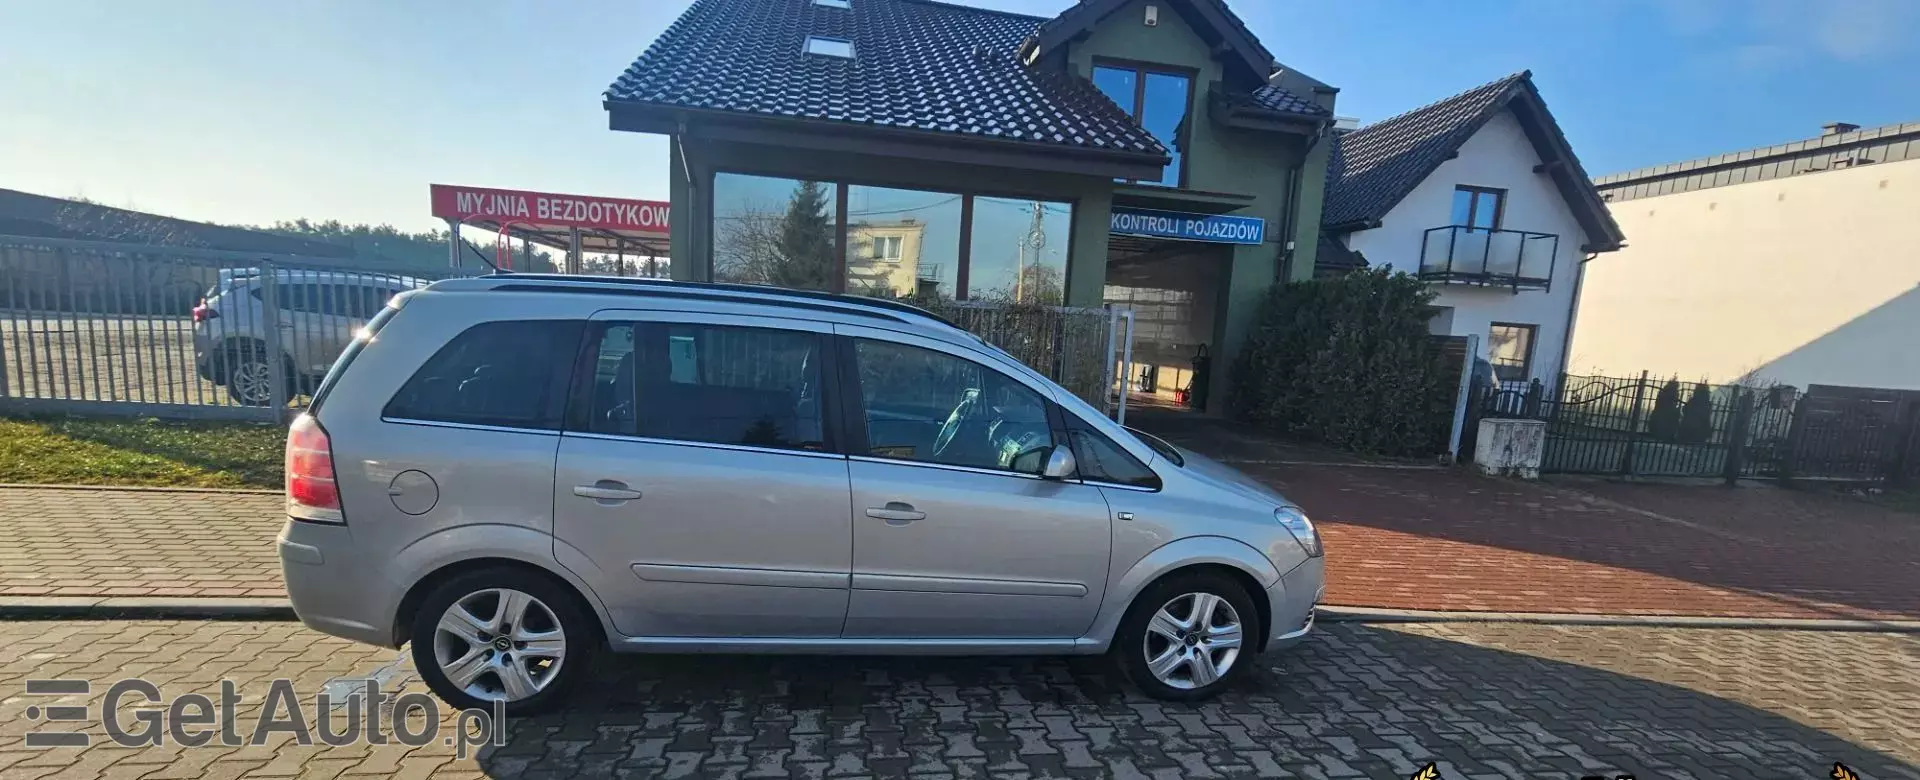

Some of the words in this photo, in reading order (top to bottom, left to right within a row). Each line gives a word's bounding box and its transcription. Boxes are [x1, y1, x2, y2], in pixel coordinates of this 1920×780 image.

[456, 191, 530, 217] MYJNIA
[537, 197, 670, 227] BEZDOTYKOW
[1111, 212, 1179, 234] KONTROLI
[1186, 219, 1260, 240] POJAZDÓW
